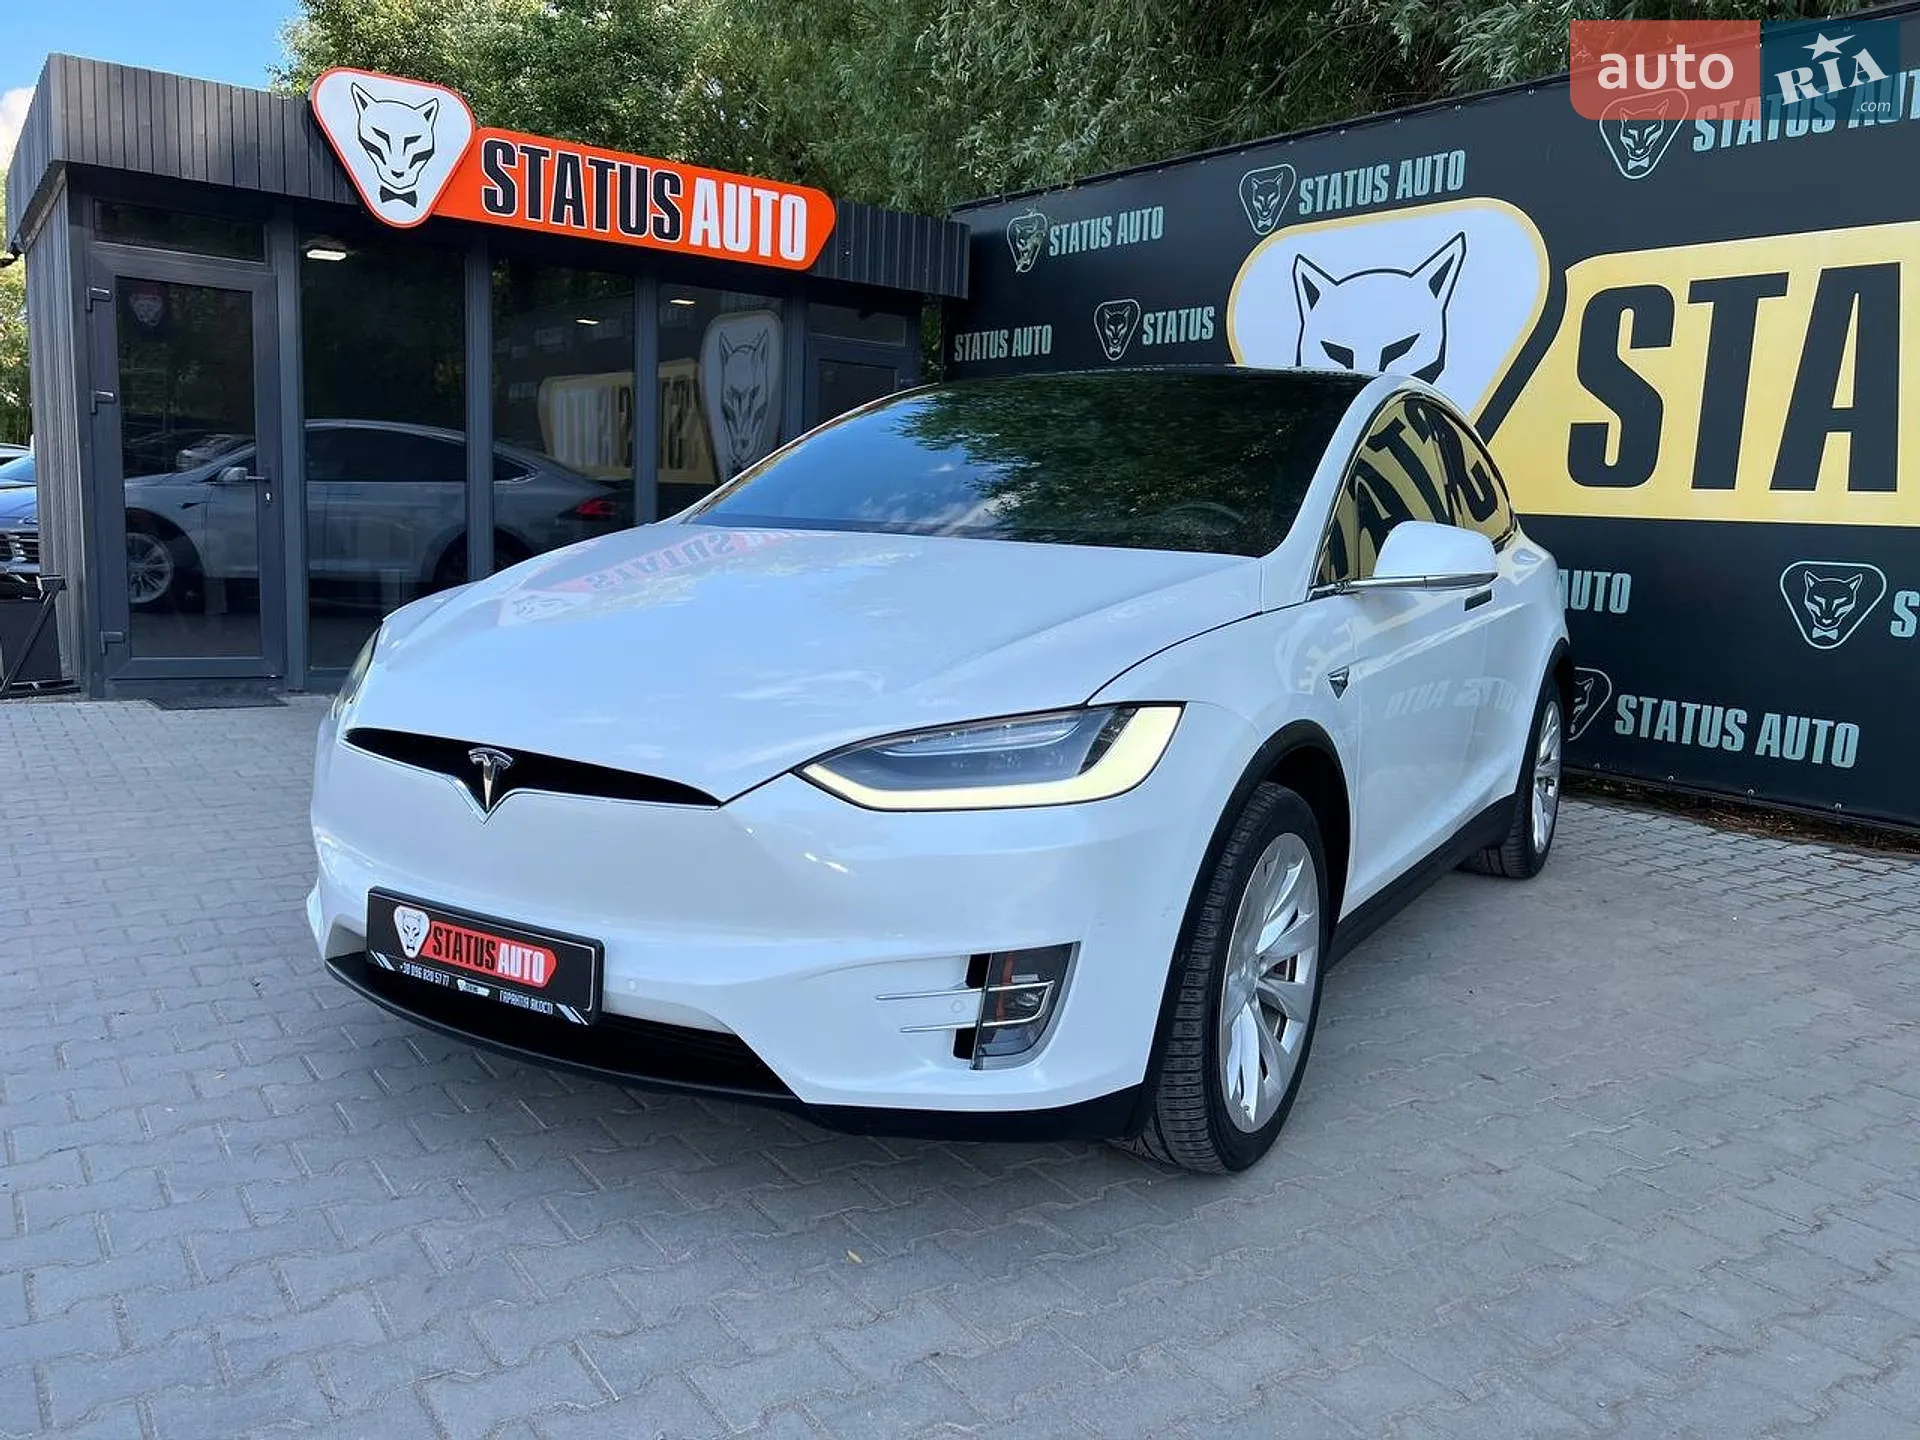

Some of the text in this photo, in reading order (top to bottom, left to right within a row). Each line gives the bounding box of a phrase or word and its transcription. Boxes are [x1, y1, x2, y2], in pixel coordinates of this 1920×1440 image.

[481, 138, 807, 262] STATUS AUTO
[1298, 150, 1466, 215] STATUS AUTO
[1050, 206, 1164, 256] STATUS AUTO
[954, 325, 1053, 362] STATUS AUTO
[1142, 306, 1215, 345] STATUS
[1567, 262, 1901, 493] STA
[1615, 694, 1860, 769] STATUS AUTO
[432, 926, 545, 984] STATUS AUTO
